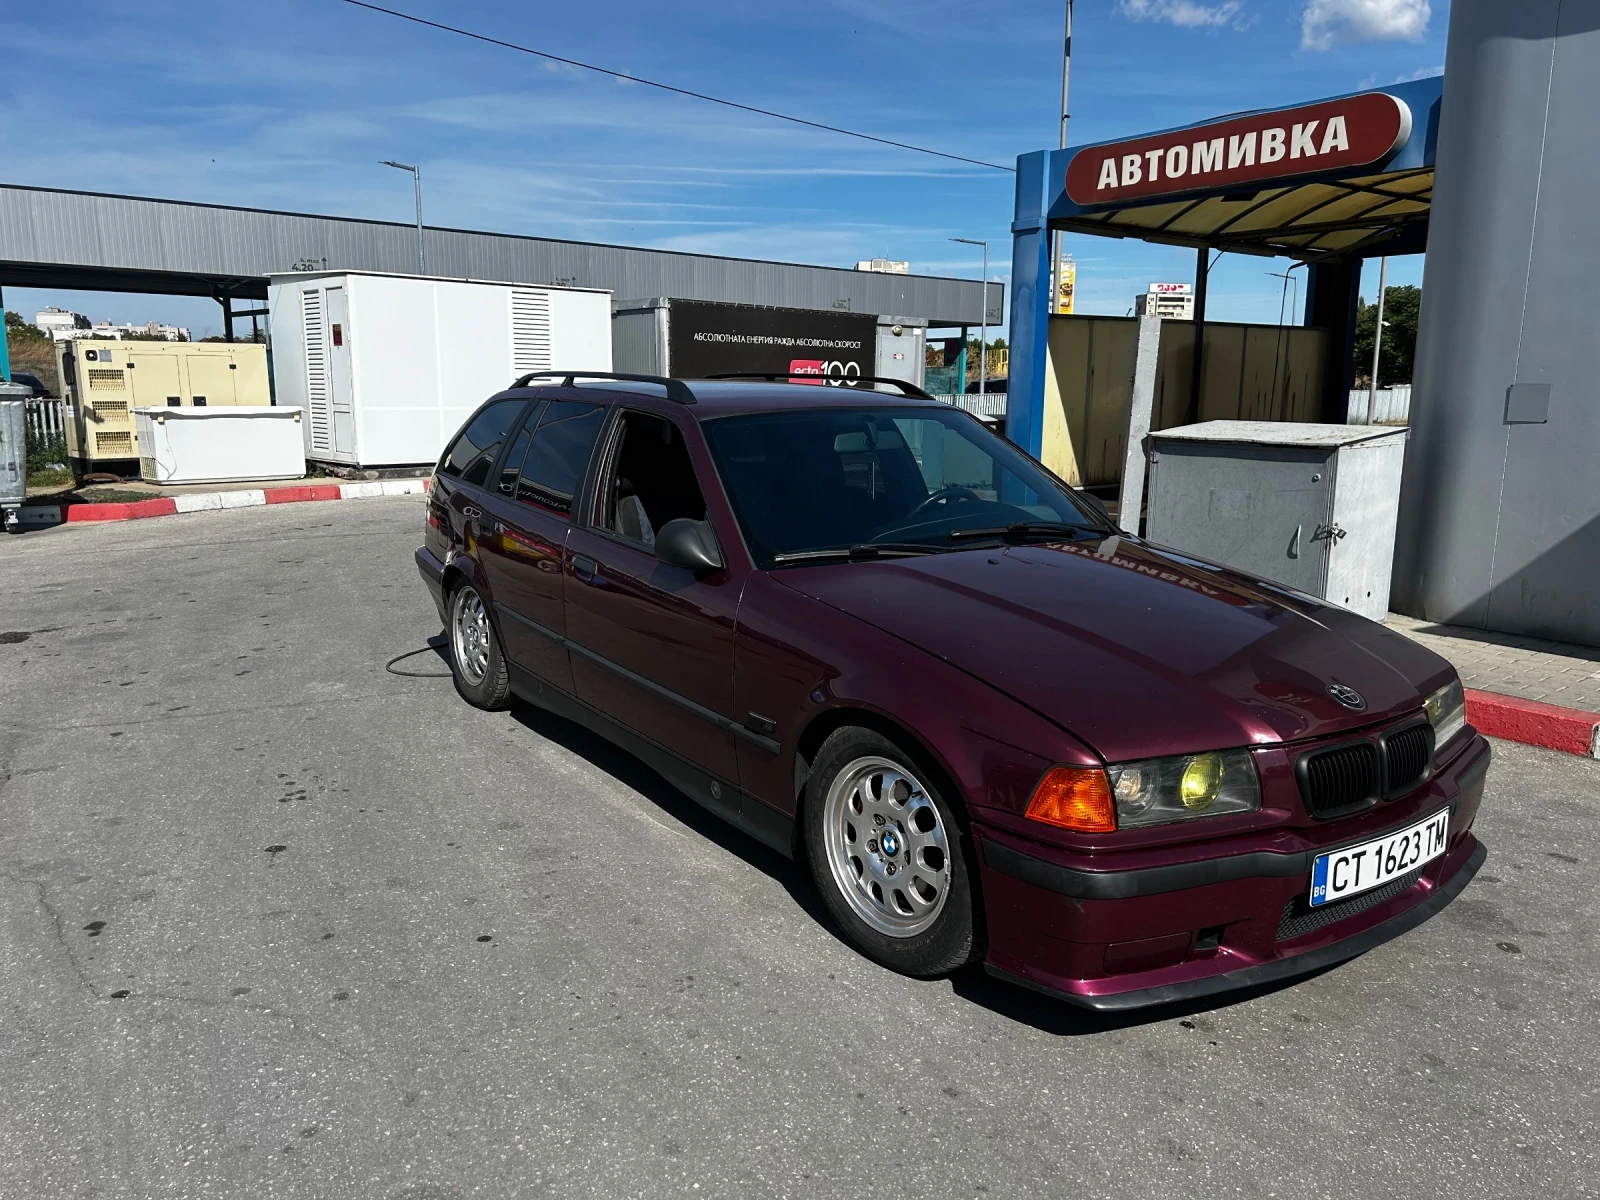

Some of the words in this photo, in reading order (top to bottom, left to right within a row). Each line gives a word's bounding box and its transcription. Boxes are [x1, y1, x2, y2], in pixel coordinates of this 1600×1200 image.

[1096, 115, 1350, 190] АВТОМИВКА
[693, 332, 746, 343] АБСОЛЮТНАТА
[746, 335, 774, 345] ЕНЕРГИЯ
[774, 337, 795, 347] РАЖДА
[796, 338, 834, 348] АБСОЛЮТНА
[834, 340, 862, 349] СКОРОСТ
[1313, 884, 1327, 898] BG
[1332, 850, 1367, 893] CT
[1375, 830, 1422, 880] 1623
[1425, 815, 1447, 857] TM
